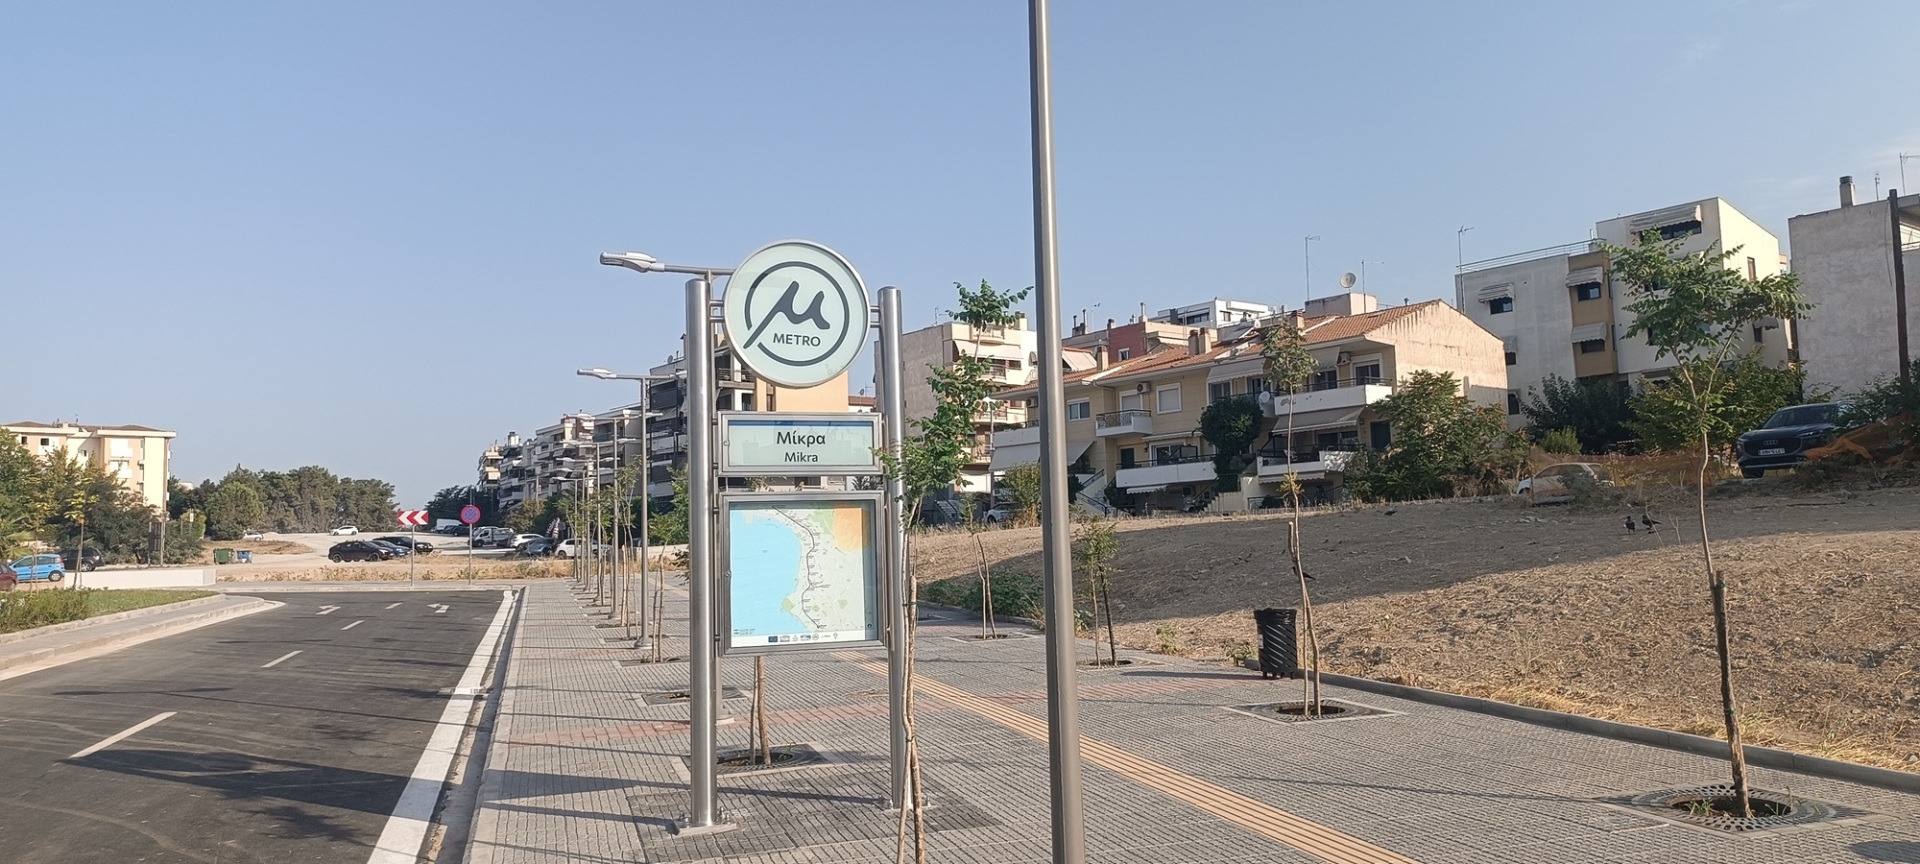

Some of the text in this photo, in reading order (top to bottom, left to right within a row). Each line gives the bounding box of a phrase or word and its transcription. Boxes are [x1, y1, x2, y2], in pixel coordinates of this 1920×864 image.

[772, 332, 821, 347] METRO
[776, 430, 826, 447] Μίκρα
[784, 452, 819, 462] Mikra
